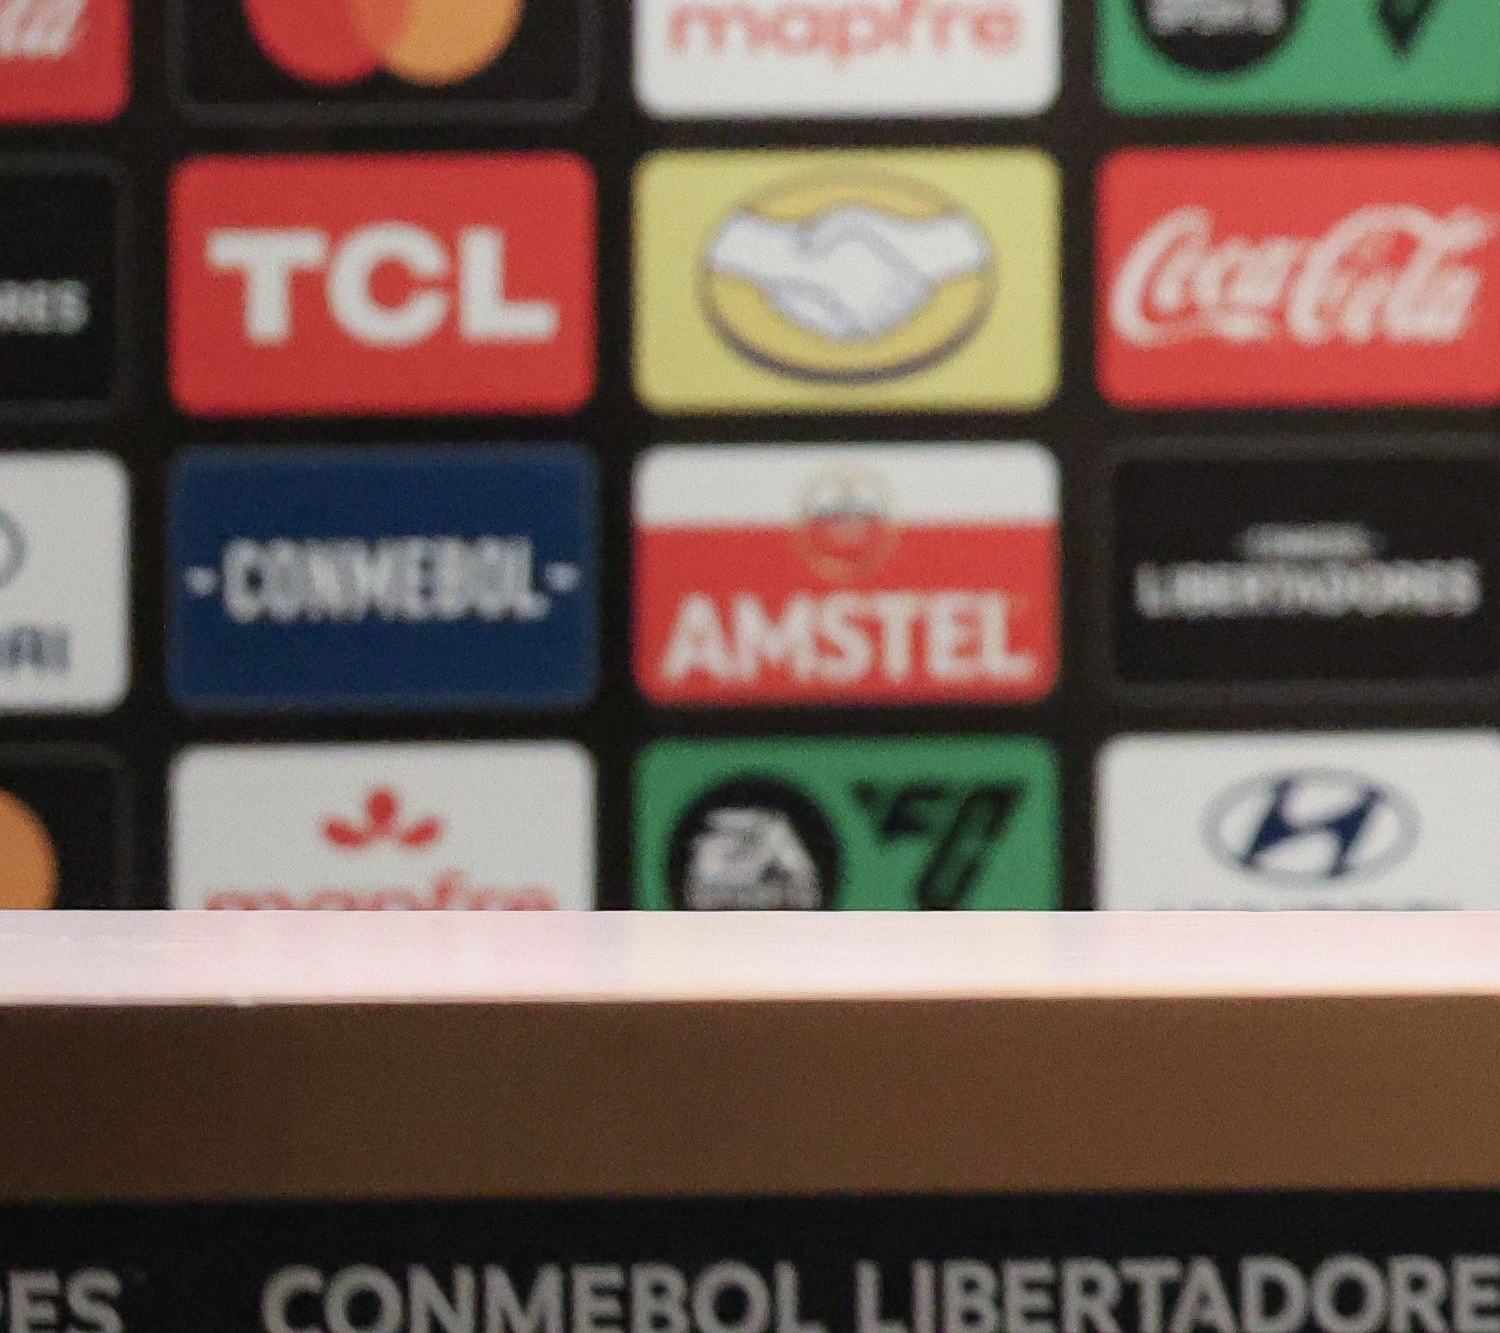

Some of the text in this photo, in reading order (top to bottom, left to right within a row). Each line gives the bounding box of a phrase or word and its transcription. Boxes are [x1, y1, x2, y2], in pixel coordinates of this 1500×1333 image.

[206, 221, 559, 347] TCL
[1110, 205, 1492, 345] Coca-Cola
[662, 589, 1036, 684] AMSTEL
[261, 1260, 827, 1333] CONMEBOL
